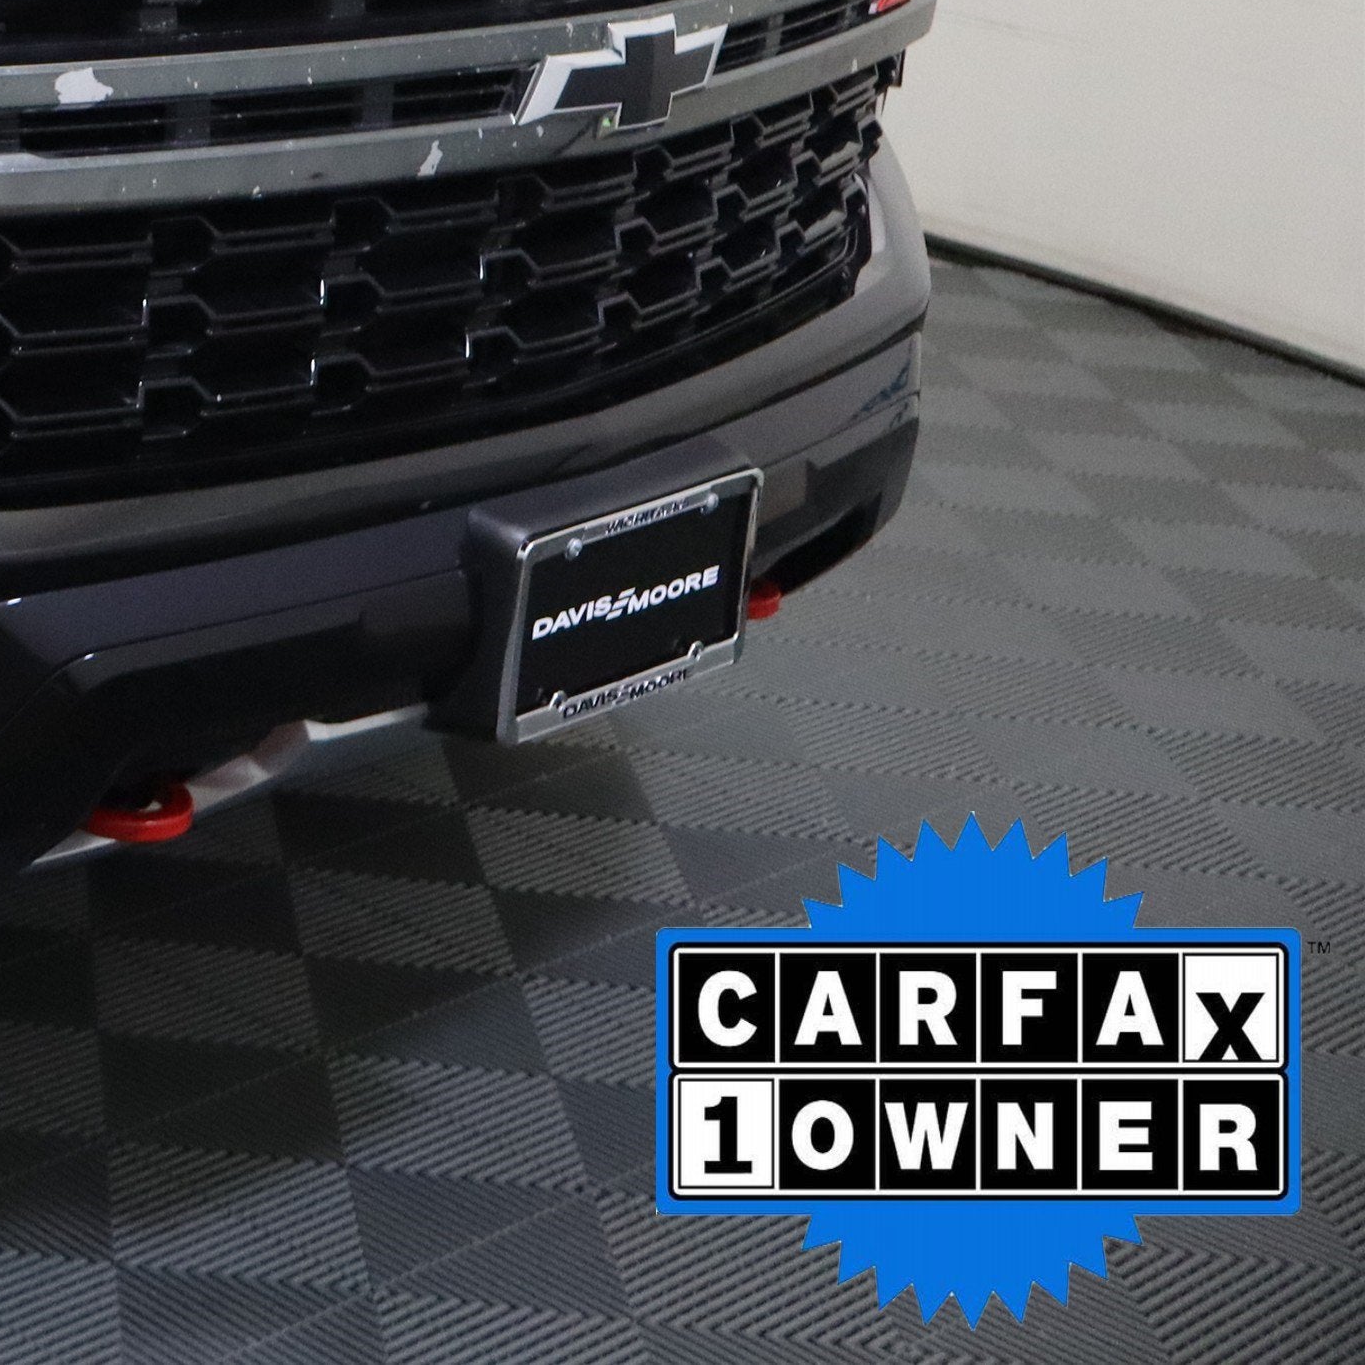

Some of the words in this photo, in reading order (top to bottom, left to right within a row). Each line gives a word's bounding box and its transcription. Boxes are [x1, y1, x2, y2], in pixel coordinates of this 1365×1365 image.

[531, 595, 613, 641] DAVIS
[627, 564, 721, 615] MOORE
[563, 689, 618, 719] DAVIS
